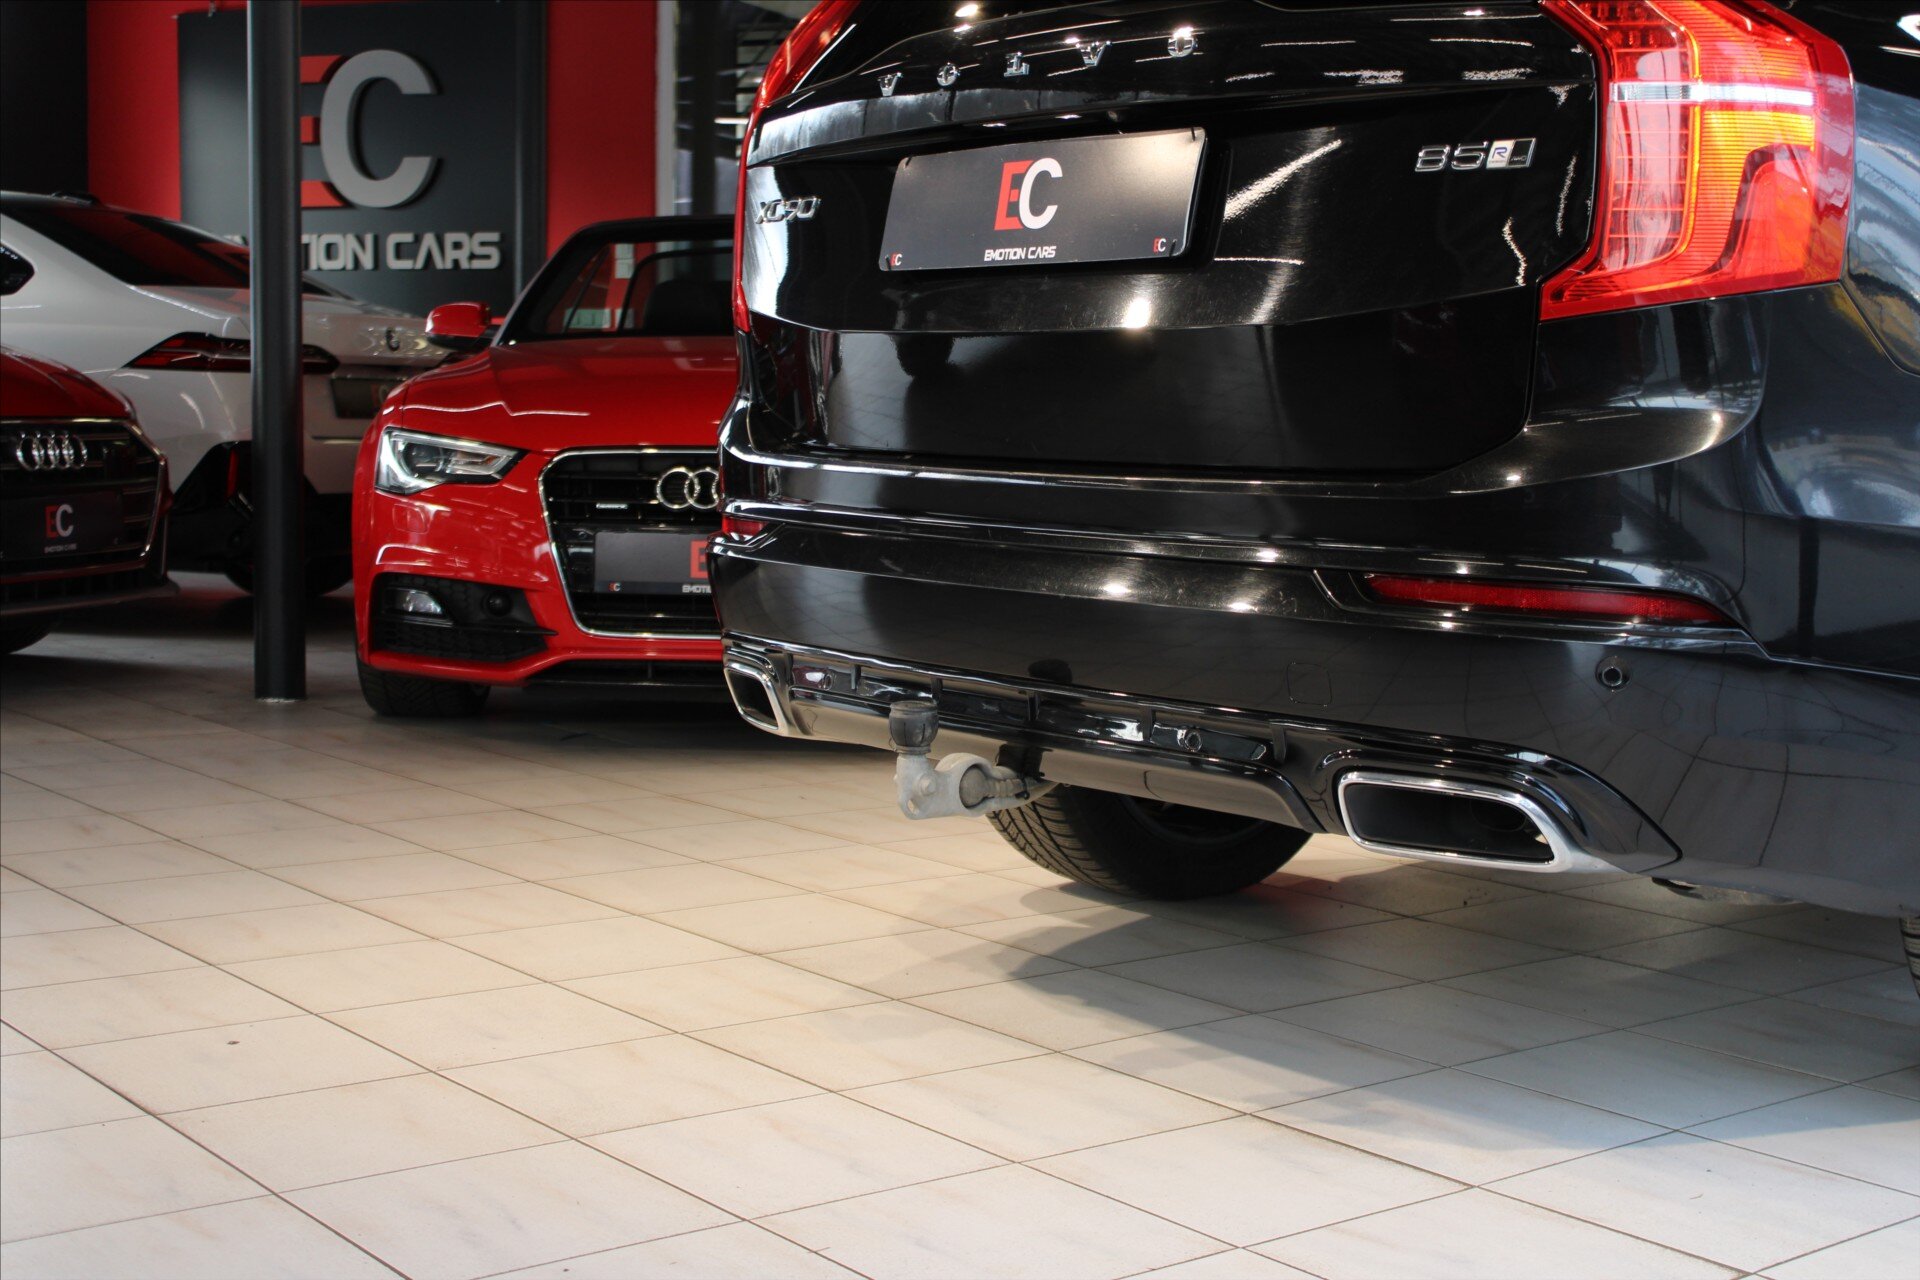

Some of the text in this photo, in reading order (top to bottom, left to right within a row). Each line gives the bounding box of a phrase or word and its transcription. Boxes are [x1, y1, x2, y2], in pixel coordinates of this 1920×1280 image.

[879, 27, 1197, 97] VOLVO
[756, 197, 821, 224] XC90
[994, 157, 1064, 231] EC
[386, 231, 501, 271] CARS
[983, 245, 1057, 262] EMOTION CARS
[46, 505, 74, 537] EC
